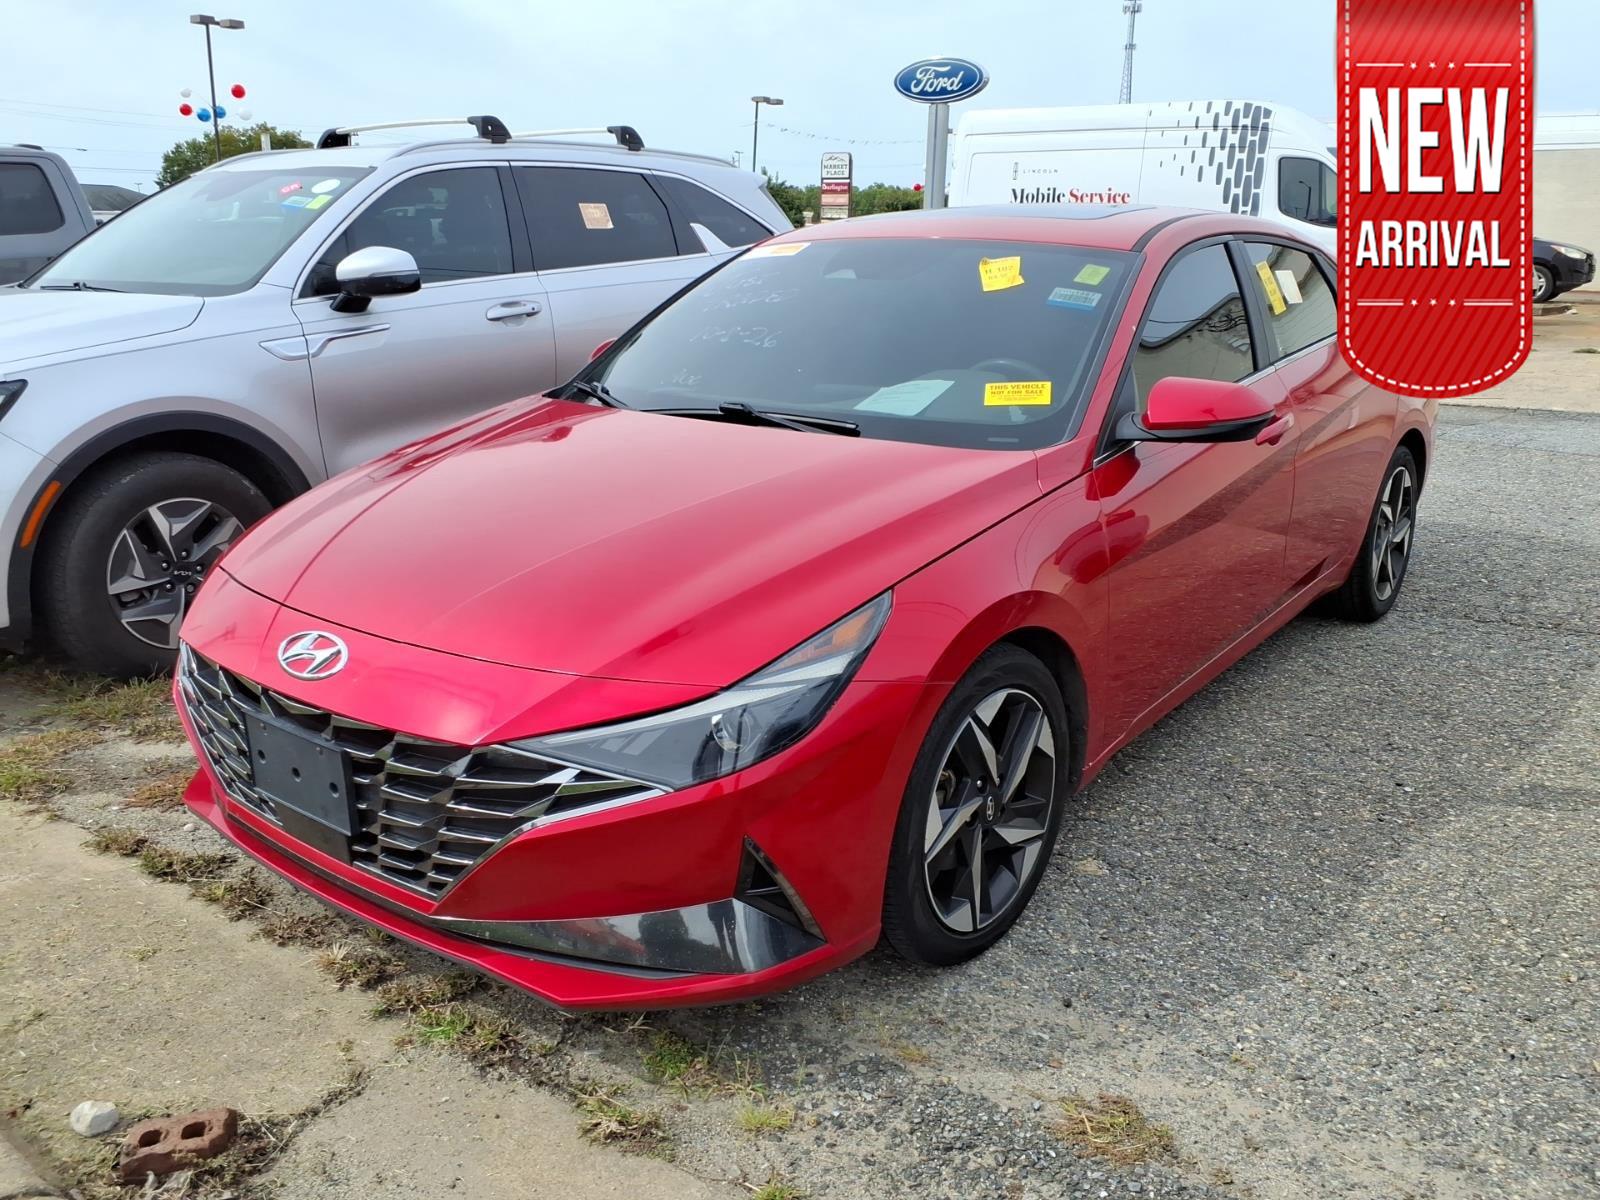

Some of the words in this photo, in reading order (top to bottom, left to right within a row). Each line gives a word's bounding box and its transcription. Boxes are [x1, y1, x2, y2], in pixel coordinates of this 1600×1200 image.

[911, 65, 964, 93] Ford
[1010, 187, 1065, 204] Mobile
[1068, 187, 1130, 204] Service
